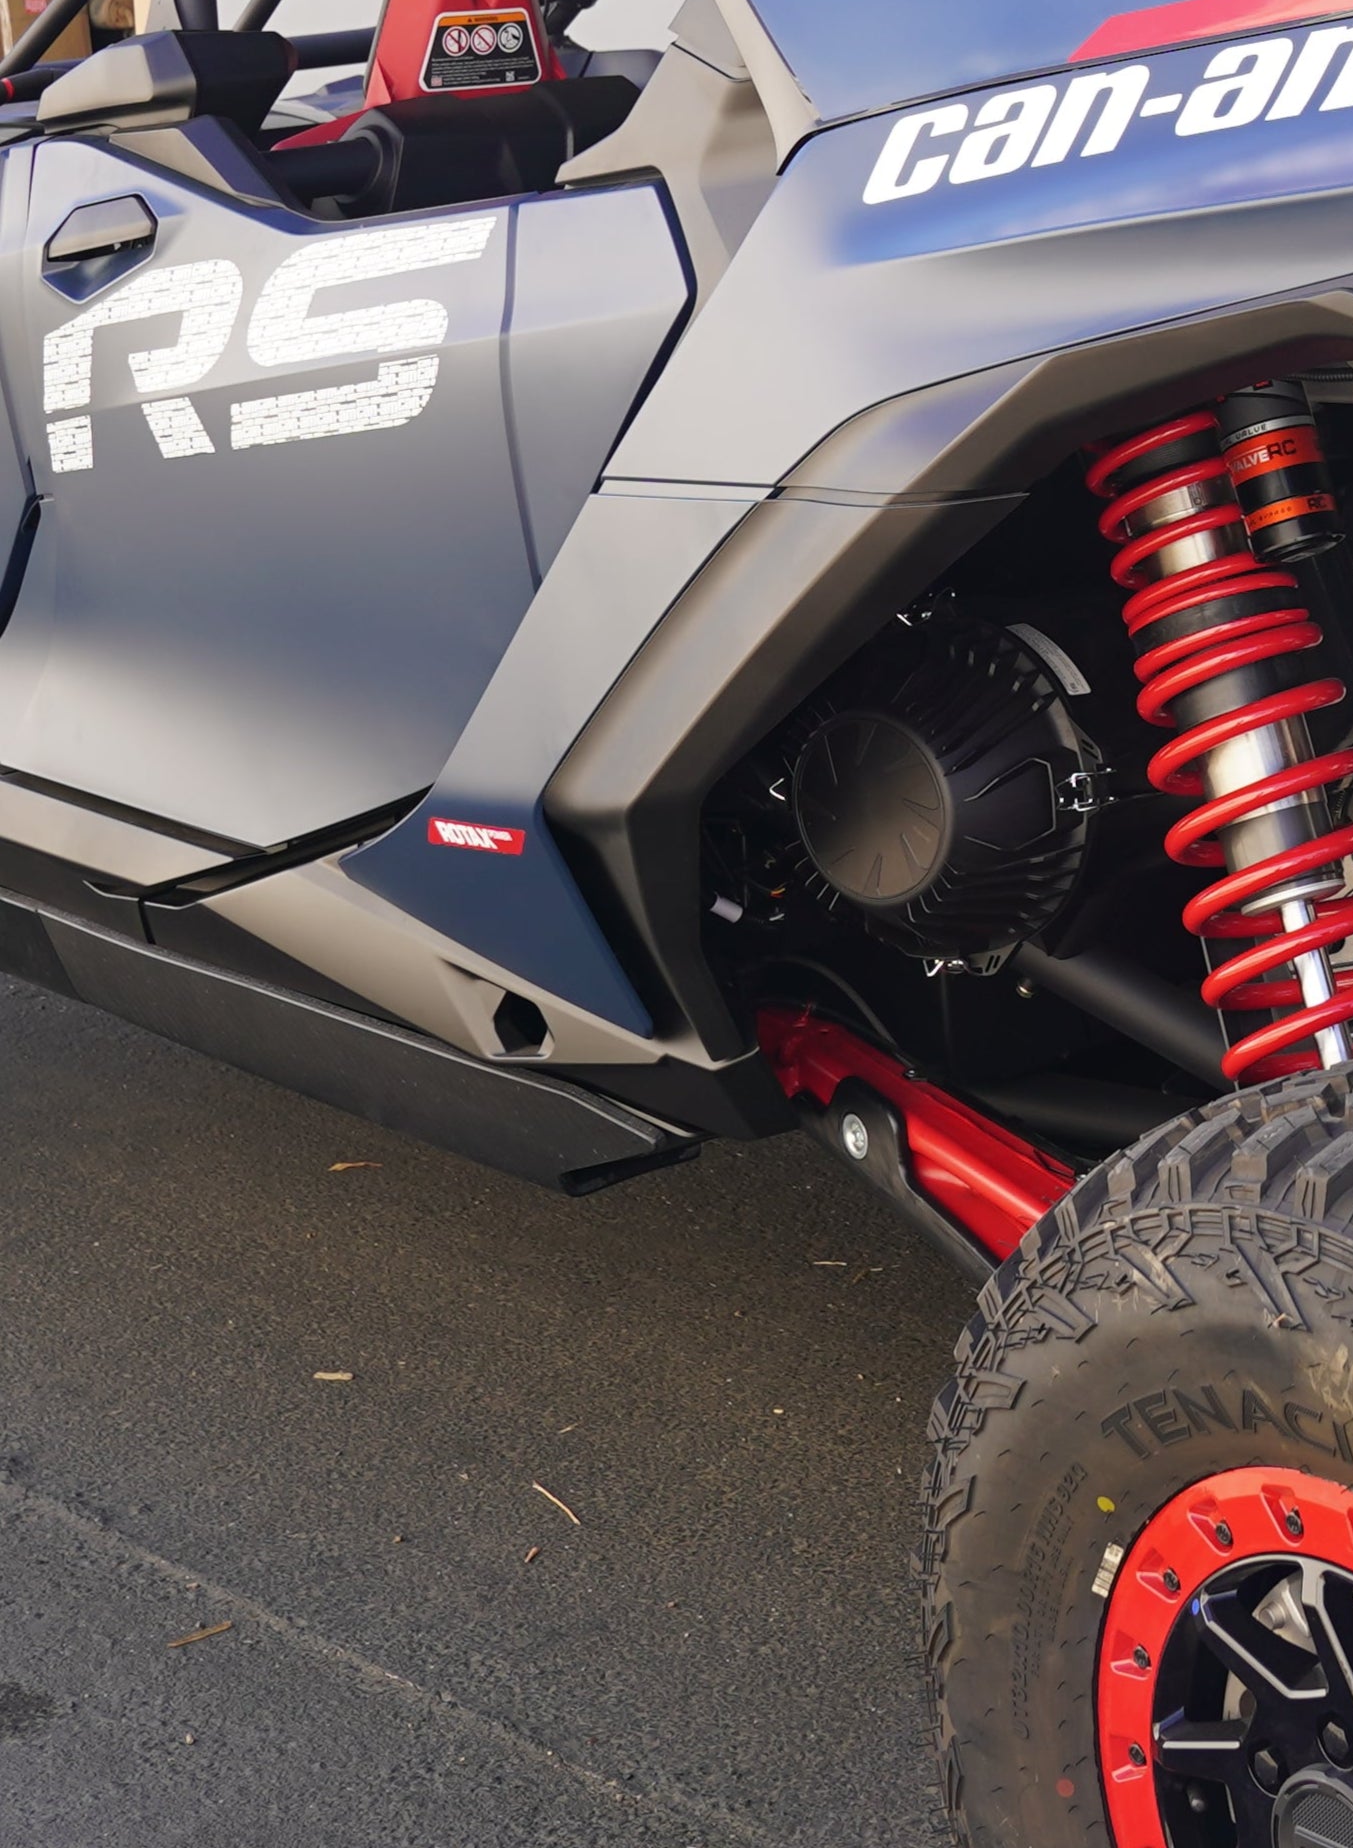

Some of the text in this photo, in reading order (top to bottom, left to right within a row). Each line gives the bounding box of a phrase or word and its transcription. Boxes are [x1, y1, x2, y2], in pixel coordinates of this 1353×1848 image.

[43, 216, 497, 474] RS
[1266, 439, 1297, 461] RC
[434, 820, 498, 850] ROTAX
